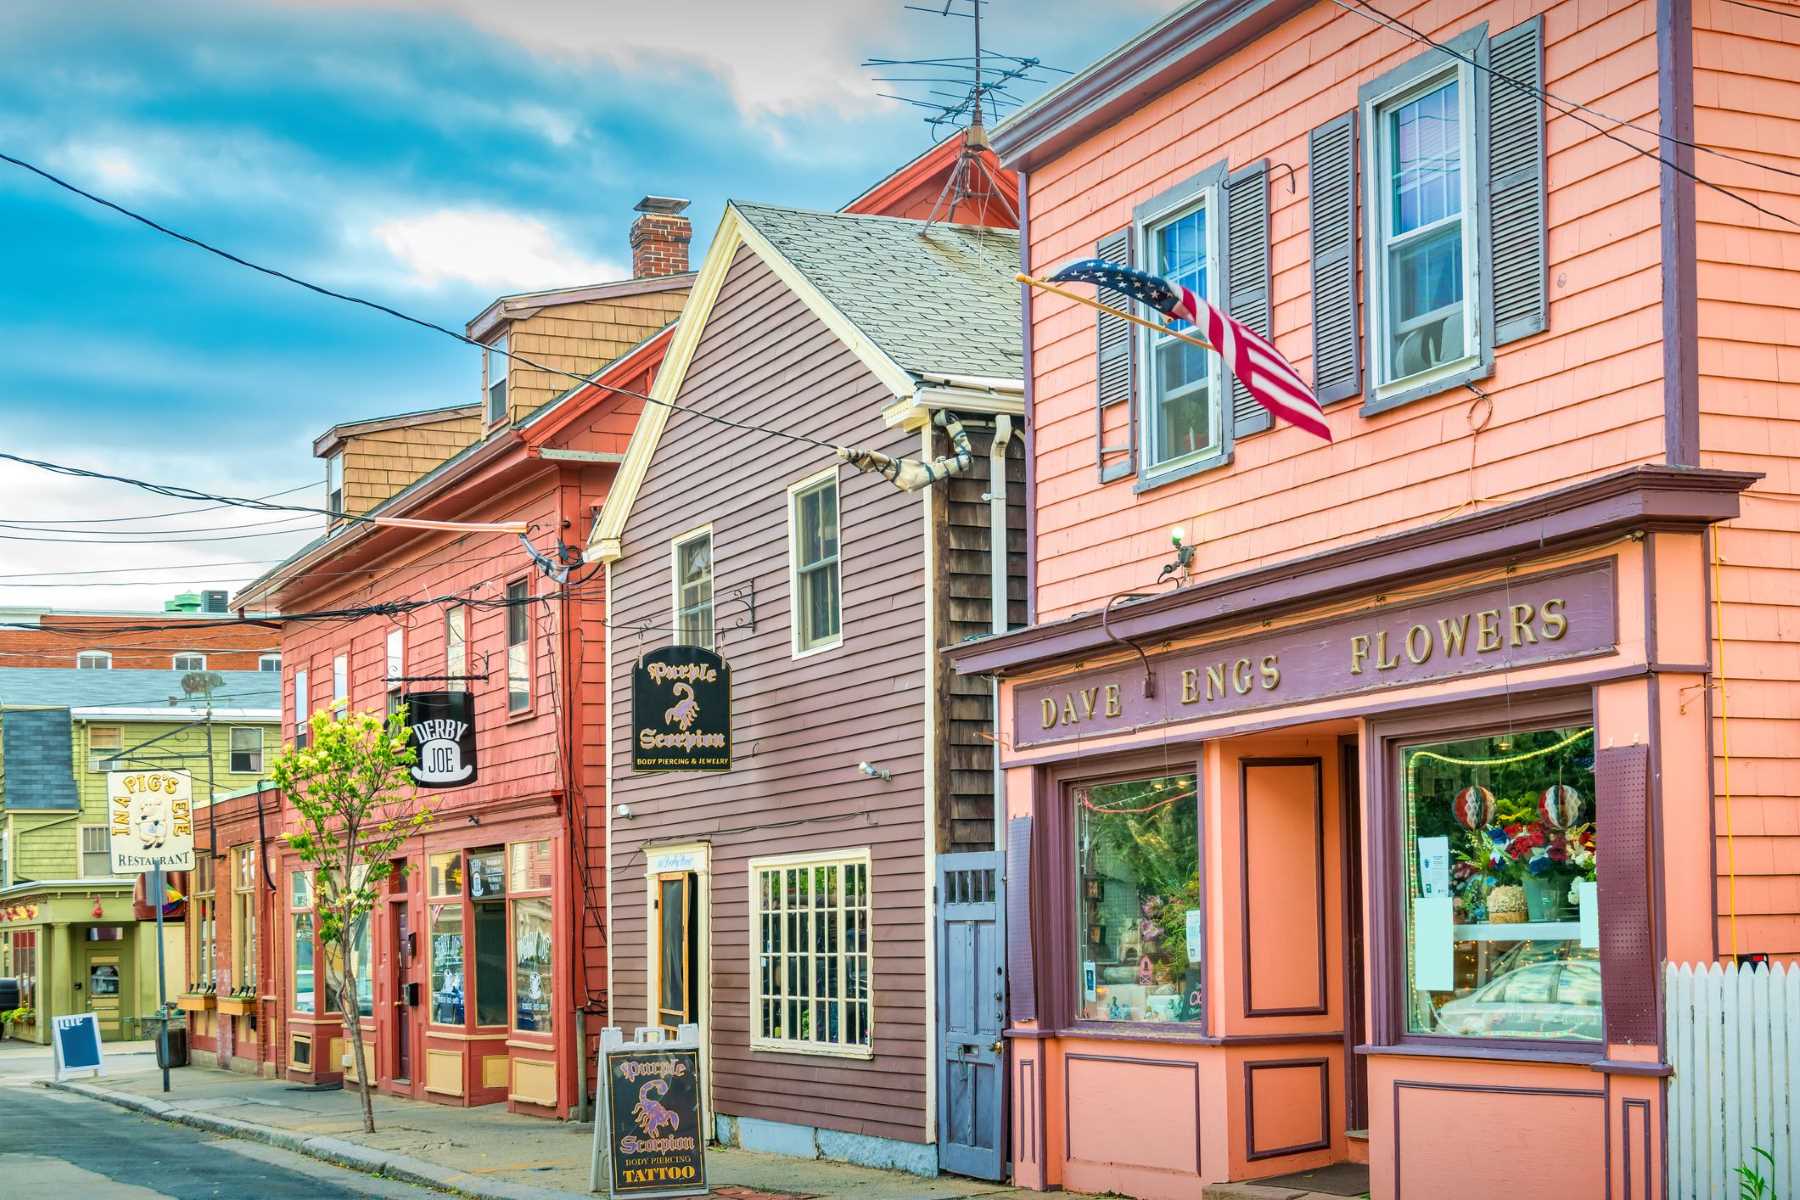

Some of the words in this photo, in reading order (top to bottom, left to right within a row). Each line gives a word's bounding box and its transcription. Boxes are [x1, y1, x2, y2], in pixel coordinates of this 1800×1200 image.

[647, 662, 717, 686] Purple
[1041, 684, 1122, 729] DAVE
[1181, 656, 1281, 704] ENGS
[1350, 599, 1569, 675] FLOWERS
[412, 719, 469, 744] DERBY
[640, 728, 726, 753] Scorpion
[428, 747, 453, 773] JOE
[123, 774, 179, 794] PIG'S
[113, 796, 131, 808] A
[112, 811, 130, 836] IN
[172, 799, 191, 837] EYE
[620, 1058, 686, 1082] Purple
[620, 1134, 695, 1155] Scorpion
[623, 1165, 695, 1183] TATTOO
